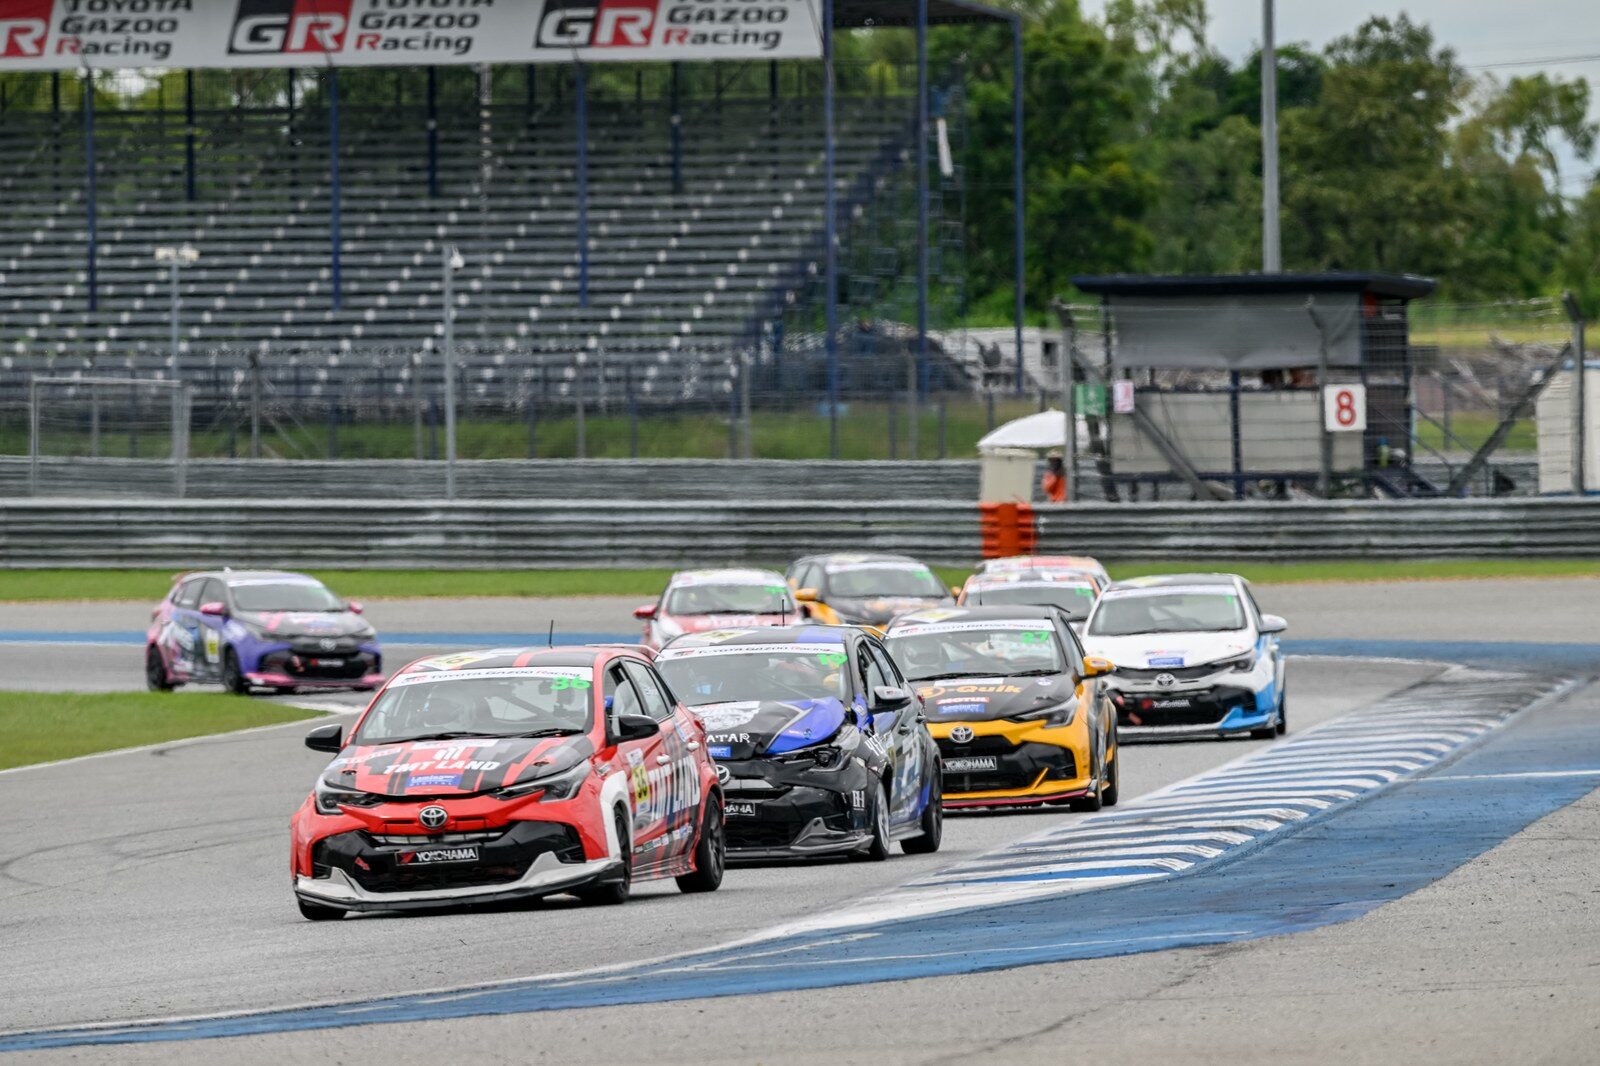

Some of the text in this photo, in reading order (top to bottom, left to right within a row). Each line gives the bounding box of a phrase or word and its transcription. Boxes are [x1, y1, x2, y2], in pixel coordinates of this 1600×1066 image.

[359, 11, 480, 30] GAZOO
[666, 5, 789, 24] GAZOO
[59, 15, 179, 34] GAZOO
[231, 12, 346, 51] GR
[538, 6, 654, 46] GR
[356, 32, 473, 55] Racing
[663, 25, 783, 50] Racing
[56, 36, 173, 60] Racing
[1335, 391, 1357, 427] 8
[1020, 631, 1050, 644] 27
[550, 676, 590, 691] 36
[706, 732, 751, 743] ATAR
[383, 760, 501, 775] TMT LAND
[944, 758, 995, 771] YOKOHAMA
[416, 848, 477, 862] YOKOHAMA
